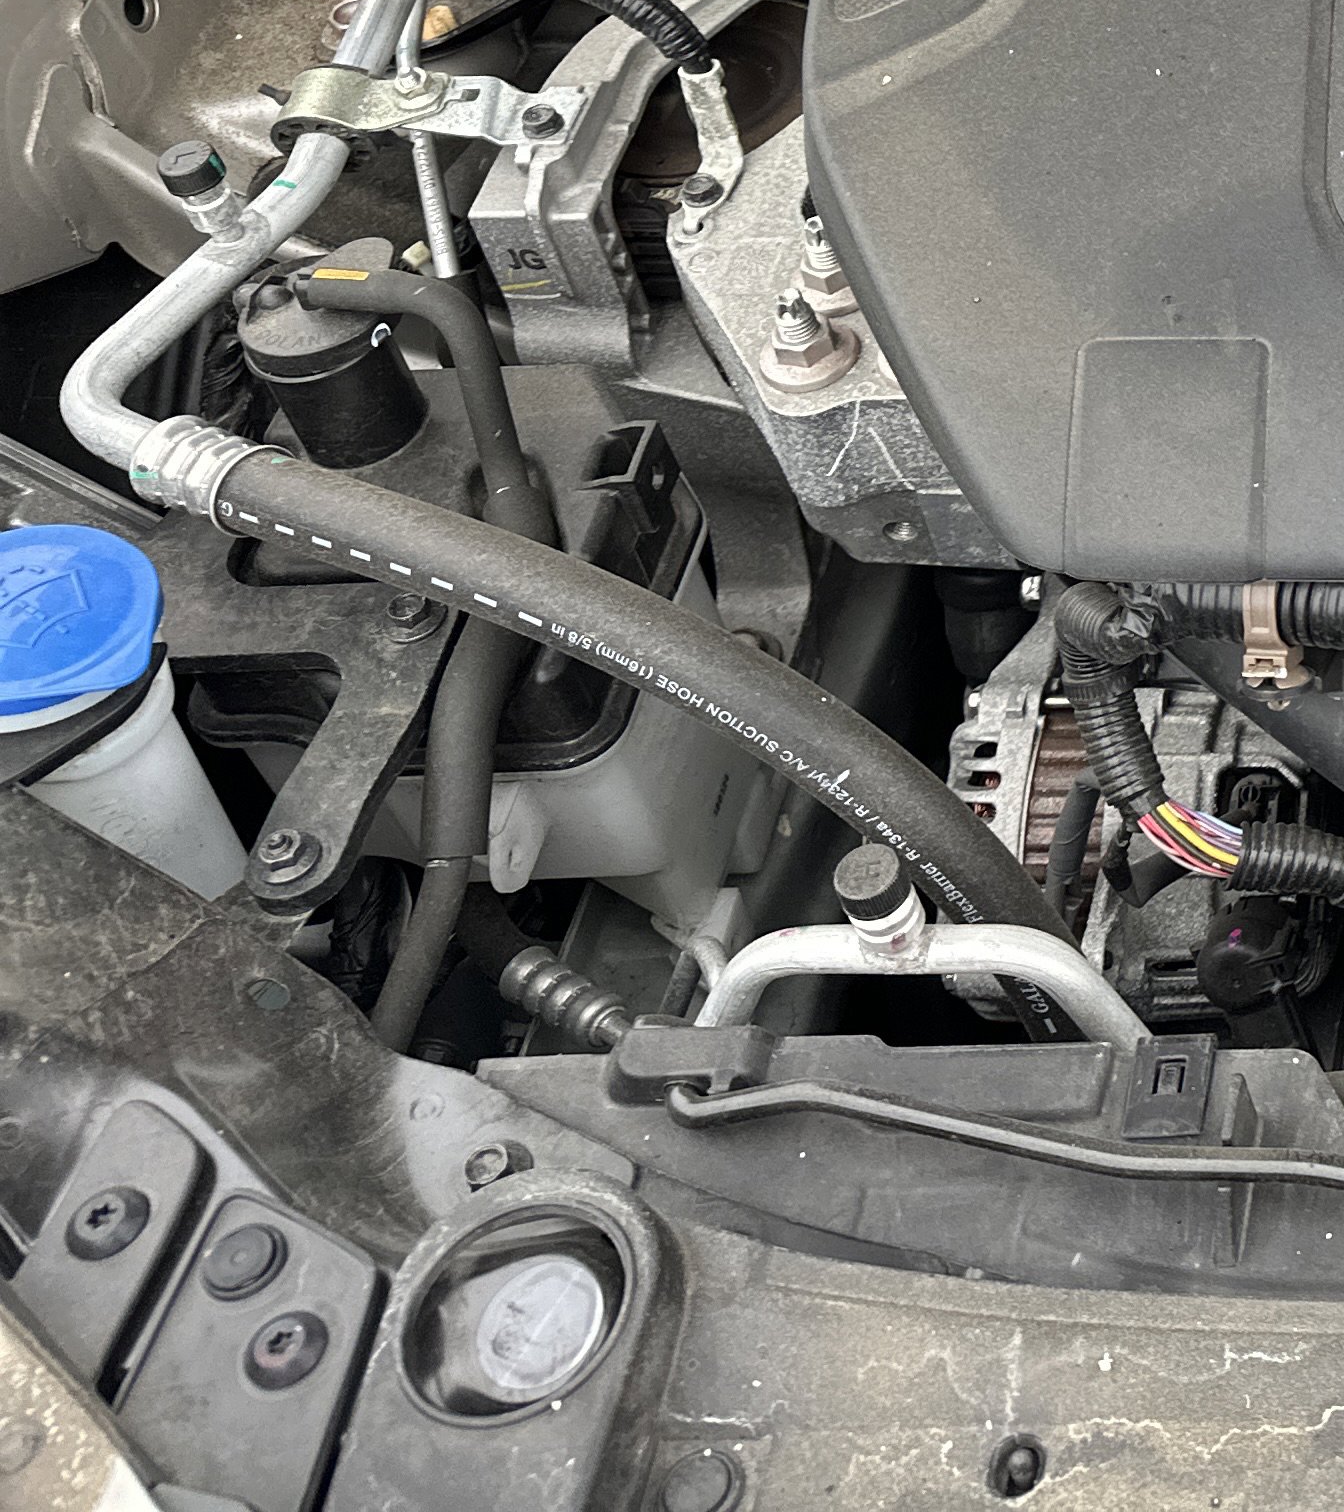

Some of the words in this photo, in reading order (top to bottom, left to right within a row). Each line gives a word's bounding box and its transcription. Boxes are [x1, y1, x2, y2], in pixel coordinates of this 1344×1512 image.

[507, 248, 548, 270] JG
[550, 622, 566, 638] in
[567, 630, 593, 651] 5/8
[595, 641, 655, 681] (16mm)
[655, 673, 705, 708] HOSE
[705, 702, 780, 753] SUCTION
[779, 749, 810, 773] A/C
[876, 821, 922, 862] R-134a
[920, 861, 985, 924] FlexBarrier
